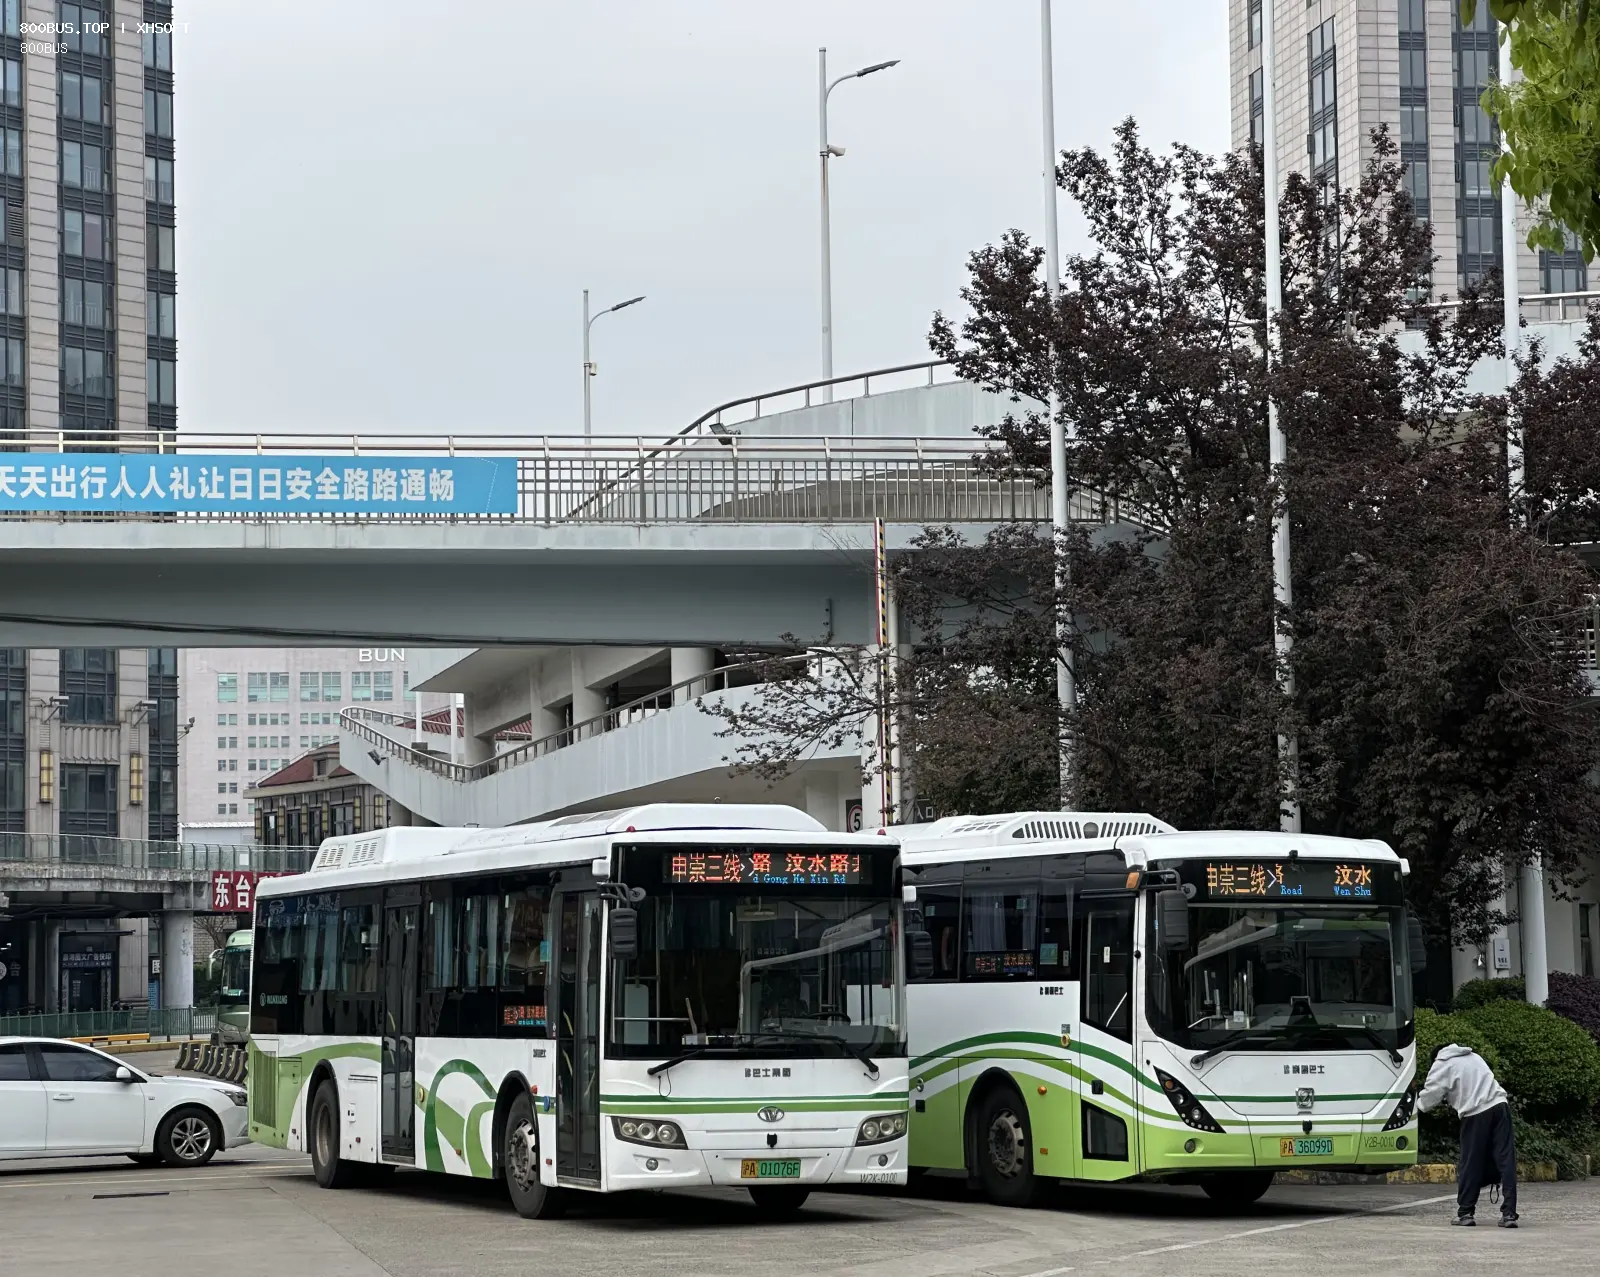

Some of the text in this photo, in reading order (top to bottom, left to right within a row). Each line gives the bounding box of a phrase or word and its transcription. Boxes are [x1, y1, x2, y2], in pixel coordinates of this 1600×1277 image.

[358, 648, 405, 662] BUN
[672, 852, 742, 883] 申崇三线
[763, 874, 788, 885] Gong
[810, 874, 829, 884] Xin
[833, 874, 846, 884] Rd
[1206, 862, 1267, 896] 申崇三线
[1334, 864, 1372, 886] 汶水
[1280, 885, 1303, 895] Road
[1297, 1139, 1333, 1154] 36099D
[1363, 1136, 1395, 1148] V2B-0010
[760, 1161, 800, 1176] 01076F
